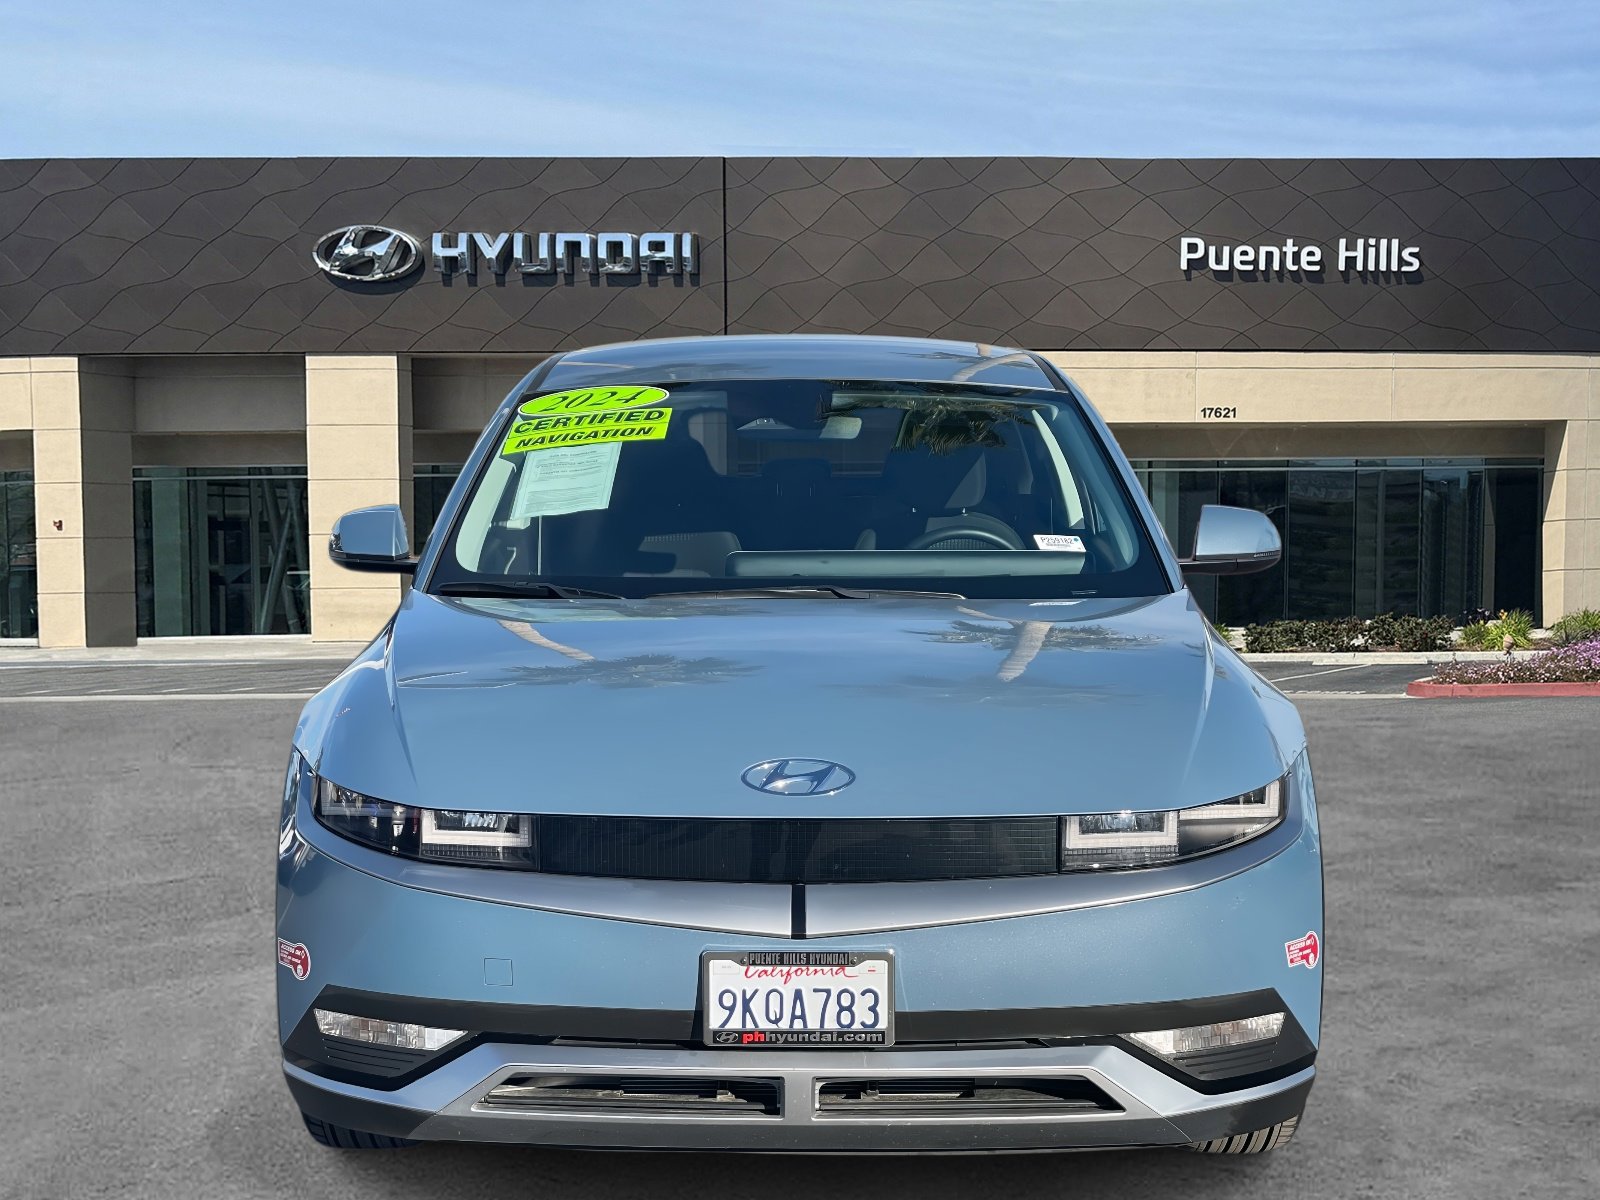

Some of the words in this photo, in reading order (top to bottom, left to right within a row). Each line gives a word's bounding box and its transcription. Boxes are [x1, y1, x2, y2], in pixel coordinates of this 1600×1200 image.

[432, 231, 698, 275] HYUNDAI
[1180, 237, 1322, 271] Puente
[1338, 238, 1421, 273] Hills
[538, 387, 649, 413] 2024
[1200, 406, 1237, 418] 17621
[513, 409, 667, 434] CERTIFIED
[515, 426, 656, 449] NAVIGATION
[749, 952, 781, 965] PUENTE
[783, 952, 807, 965] HILLS
[809, 952, 849, 965] HYUNDAI
[744, 965, 858, 985] California
[717, 987, 880, 1029] 9KQA783
[741, 1031, 883, 1045] phhyundai.com
